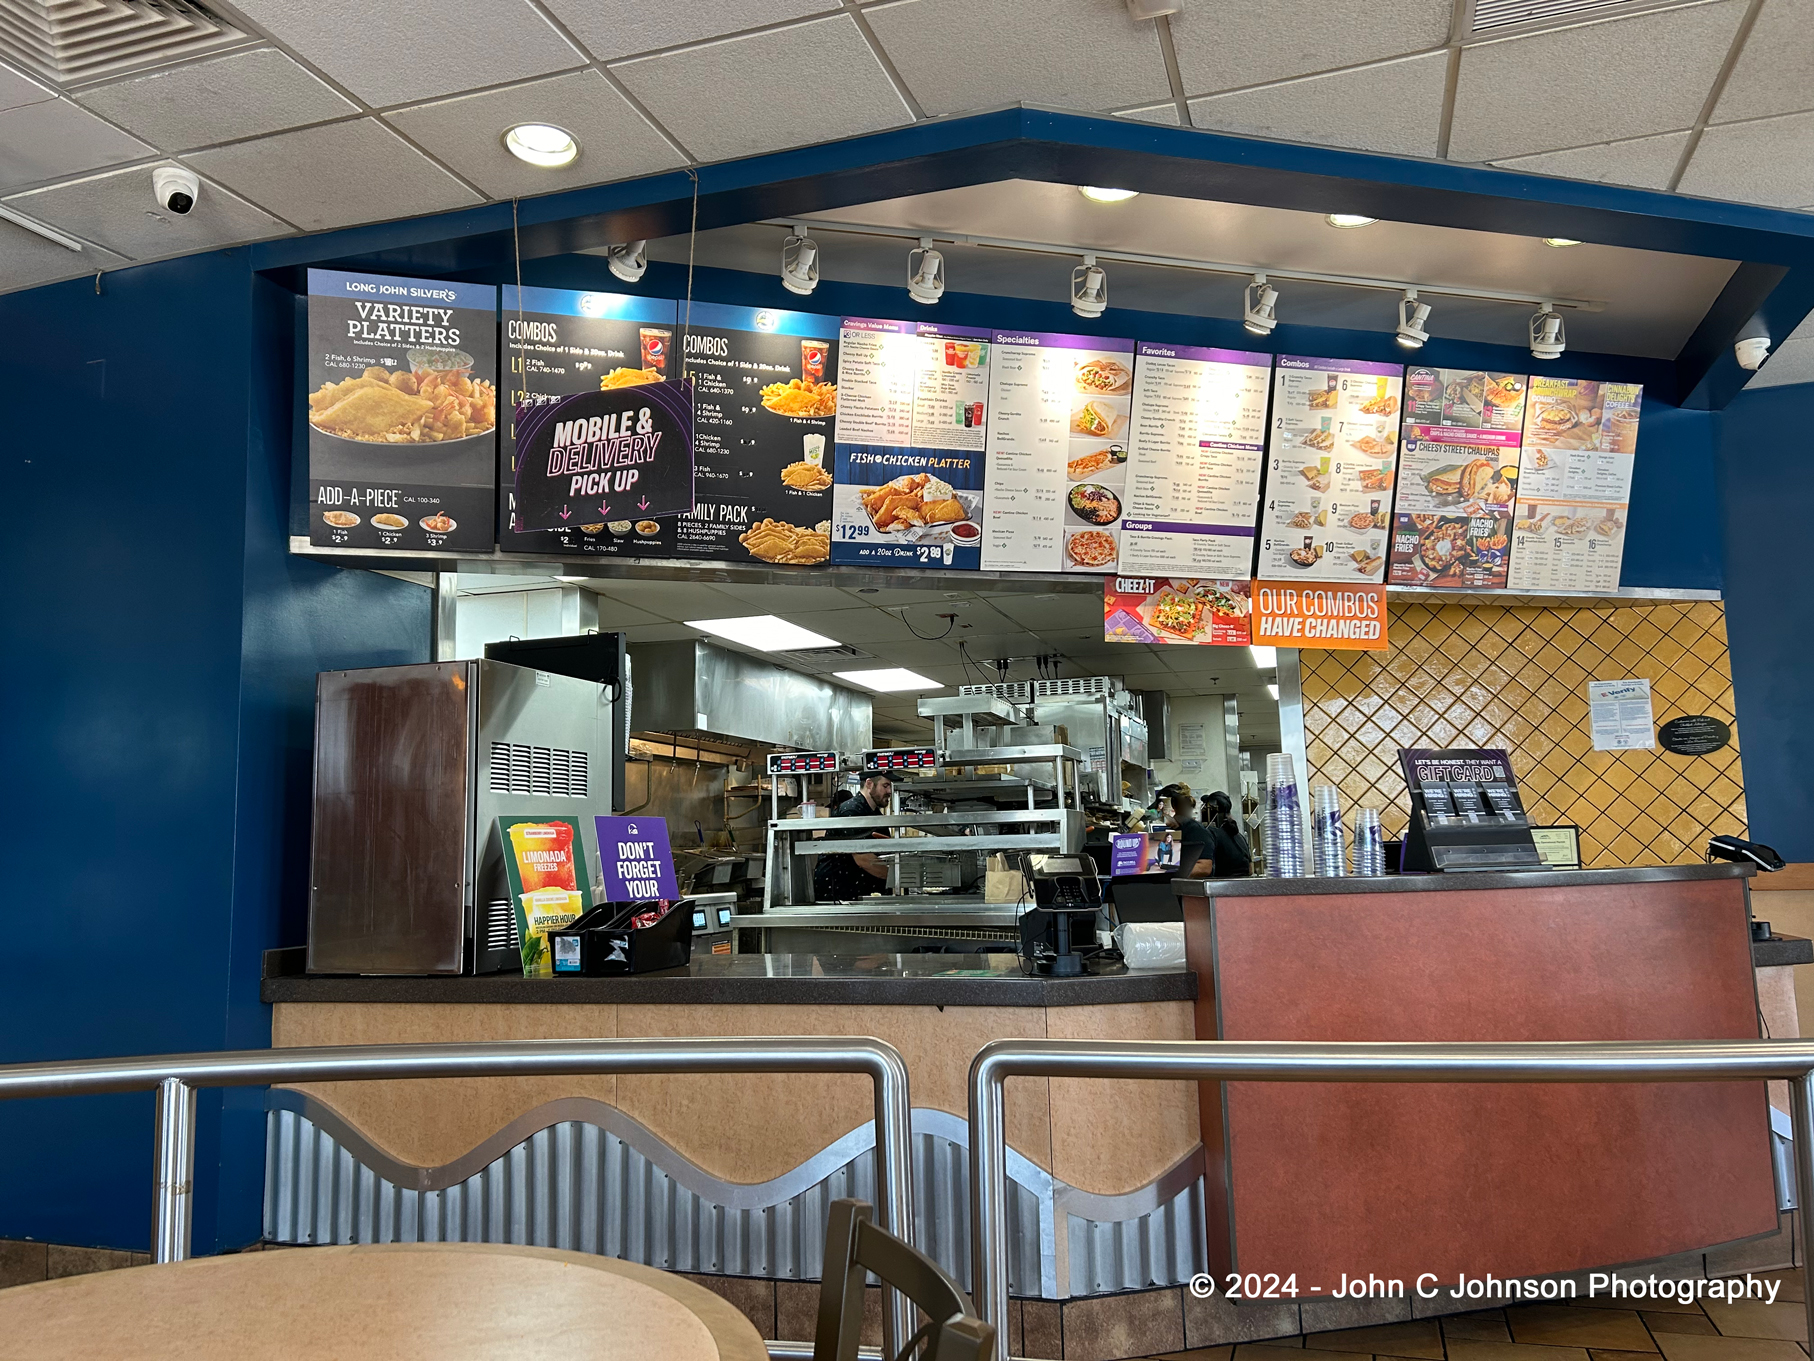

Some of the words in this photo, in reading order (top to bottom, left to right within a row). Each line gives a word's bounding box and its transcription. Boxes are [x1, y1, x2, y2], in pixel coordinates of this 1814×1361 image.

[346, 281, 377, 293] LONG
[379, 284, 408, 296] JOHN
[410, 287, 457, 302] SILVER'S
[355, 301, 454, 326] VARIETY
[843, 319, 867, 329] Cravings
[868, 321, 883, 330] Value
[920, 324, 938, 332] Drinks
[347, 320, 460, 346] PLATTERS
[508, 320, 557, 343] COMBOS
[861, 331, 876, 340] LESS
[683, 334, 729, 357] COMBOS
[997, 334, 1039, 345] Specialties
[509, 342, 534, 350] Includes
[535, 344, 555, 352] Choice
[1142, 346, 1176, 357] Favorites
[324, 360, 338, 368] CAL
[352, 355, 376, 364] Shrimp
[1281, 358, 1310, 369] Combos
[704, 379, 727, 387] Chicken
[1280, 373, 1286, 387] 1
[1341, 379, 1348, 391] 6
[702, 403, 714, 411] Fish
[702, 410, 723, 418] Shrimp
[553, 410, 634, 448] MOBILE
[635, 407, 653, 434] &
[1276, 417, 1283, 429] 2
[1338, 421, 1345, 433] 7
[1418, 441, 1442, 452] CHEESY
[1443, 445, 1467, 454] STREET
[546, 431, 663, 477] DELIVERY
[850, 453, 875, 464] FISH
[882, 454, 927, 467] CHICKEN
[928, 457, 971, 469] PLATTER
[1273, 458, 1280, 471] 3
[1335, 462, 1342, 474] 8
[569, 471, 613, 497] PICK
[613, 469, 640, 492] UP
[317, 486, 400, 508] ADD-A-PIECE
[1269, 500, 1275, 511] 4
[1331, 503, 1338, 514] 9
[720, 504, 749, 523] PACK
[1125, 521, 1153, 530] Groups
[1470, 518, 1494, 529] NACHO
[688, 528, 727, 536] HUSHPUPPIES
[1469, 527, 1490, 537] FRIES
[1265, 539, 1271, 551] 5
[1395, 534, 1420, 544] NACHO
[1516, 535, 1526, 546] 14
[1553, 537, 1562, 548] 15
[1588, 539, 1597, 550] 16
[1324, 541, 1334, 552] 10
[1394, 543, 1414, 553] FRIES
[1259, 588, 1297, 615] OUR
[1302, 590, 1379, 618] COMBOS
[1259, 616, 1304, 637] HAVE
[1304, 617, 1381, 641] CHANGED
[1417, 765, 1451, 782] GIFT
[1452, 765, 1494, 782] CARD
[617, 841, 654, 860] DON'T
[522, 850, 567, 864] LIMONADA
[533, 862, 558, 872] FREEZES
[616, 860, 662, 879] FORGET
[625, 880, 660, 898] YOUR
[533, 914, 559, 926] HAPPIER
[560, 913, 577, 924] HOUR
